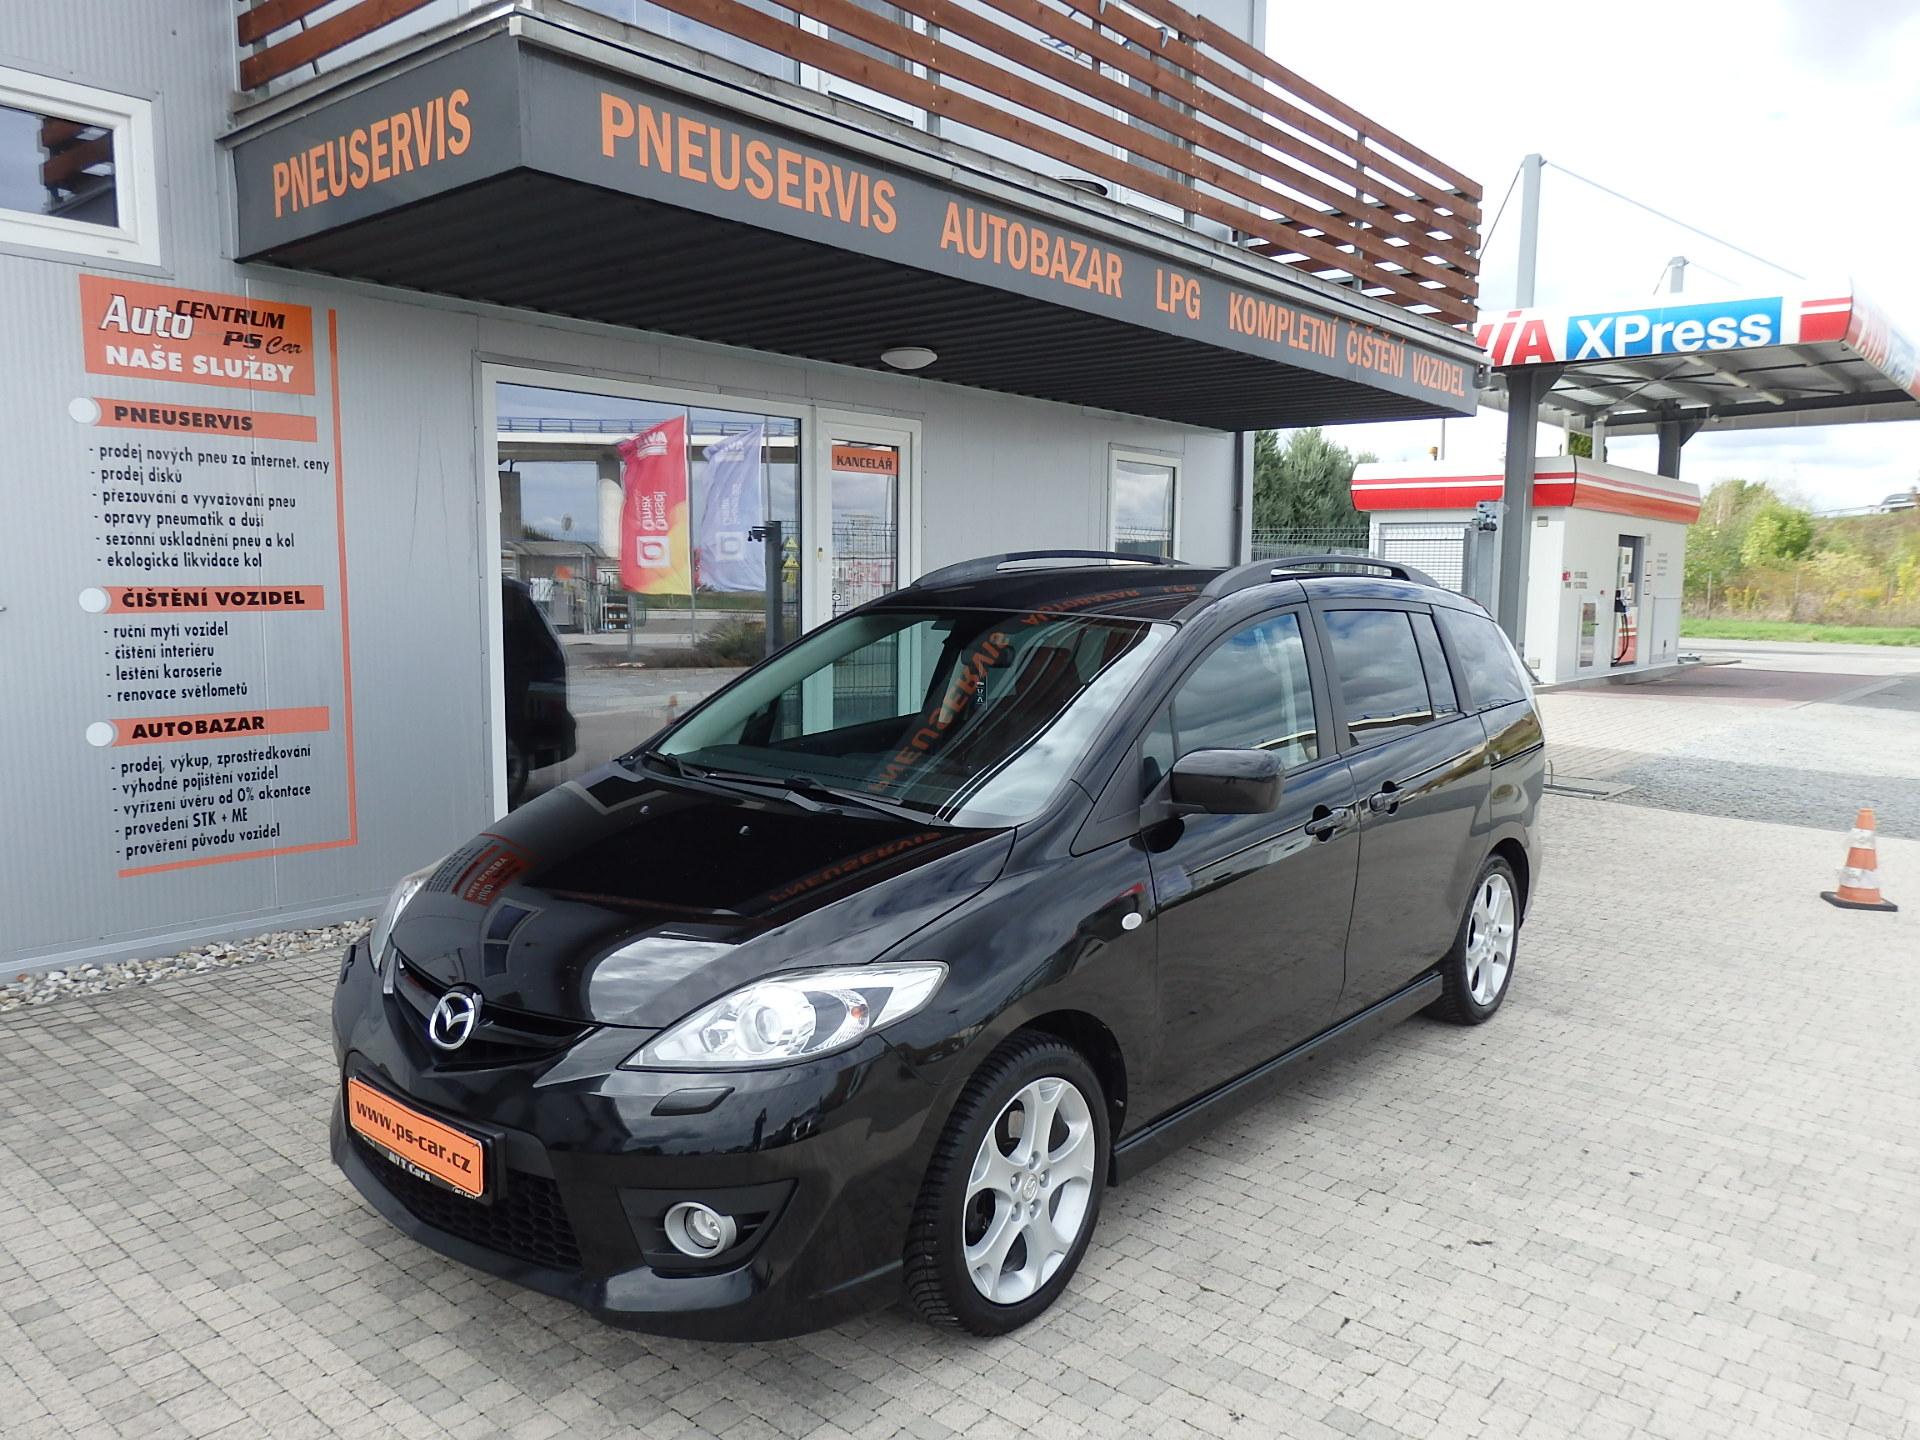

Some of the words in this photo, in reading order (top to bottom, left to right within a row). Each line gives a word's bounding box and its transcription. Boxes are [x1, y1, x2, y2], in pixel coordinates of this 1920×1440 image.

[272, 88, 472, 219] PNEUSERVIS
[600, 92, 898, 234] PNEUSERVIS
[940, 201, 1123, 298] AUTOBAZAR
[1155, 268, 1201, 321] LPG
[1229, 290, 1337, 360] KOMPLETNÍ
[1346, 319, 1406, 379] ČIŠTĚNÍ
[1412, 350, 1466, 398] VOZIDEL
[98, 293, 194, 340] Auto
[175, 299, 286, 330] CENTRUM
[222, 330, 264, 349] PS
[264, 335, 304, 356] Car
[1570, 312, 1773, 360] XPress
[105, 343, 184, 373] NAŠE
[192, 354, 295, 384] SLUŽBY
[113, 405, 254, 431] PNEUSERVIS
[99, 442, 143, 464] prodej
[146, 446, 194, 466] nových
[197, 452, 228, 468] pneu
[231, 453, 247, 466] za
[250, 450, 301, 470] internet.
[303, 459, 330, 475] ceny
[836, 454, 893, 471] KANCELÁŘ
[100, 464, 145, 486] prodej
[180, 493, 189, 505] a
[268, 496, 297, 511] pneu
[103, 512, 152, 529] opravy
[156, 510, 225, 529] pneumatik
[228, 516, 237, 527] a
[232, 535, 262, 551] pneu
[265, 537, 273, 548] a
[276, 531, 295, 548] kol
[183, 551, 240, 568] likvidace
[243, 552, 263, 568] kol
[121, 587, 208, 608] ČIŠTĚNÍ
[214, 590, 306, 607] VOZIDEL
[113, 623, 147, 639] ruční
[184, 620, 229, 638] vozidel
[163, 661, 223, 679] karoserie
[117, 688, 177, 702] renovace
[181, 681, 248, 699] světlometů
[131, 715, 266, 739] AUTOBAZAR
[120, 755, 166, 778] prodej,
[170, 752, 213, 773] výkup,
[236, 764, 279, 783] vozidel
[218, 788, 233, 804] od
[237, 786, 255, 803] 0%
[258, 784, 312, 801] akontace
[124, 815, 189, 840] provedení
[192, 811, 217, 828] STK
[231, 807, 249, 823] ME
[191, 828, 236, 851] původu
[239, 821, 281, 842] vozidel
[355, 1100, 472, 1174] www.ps-car.cz
